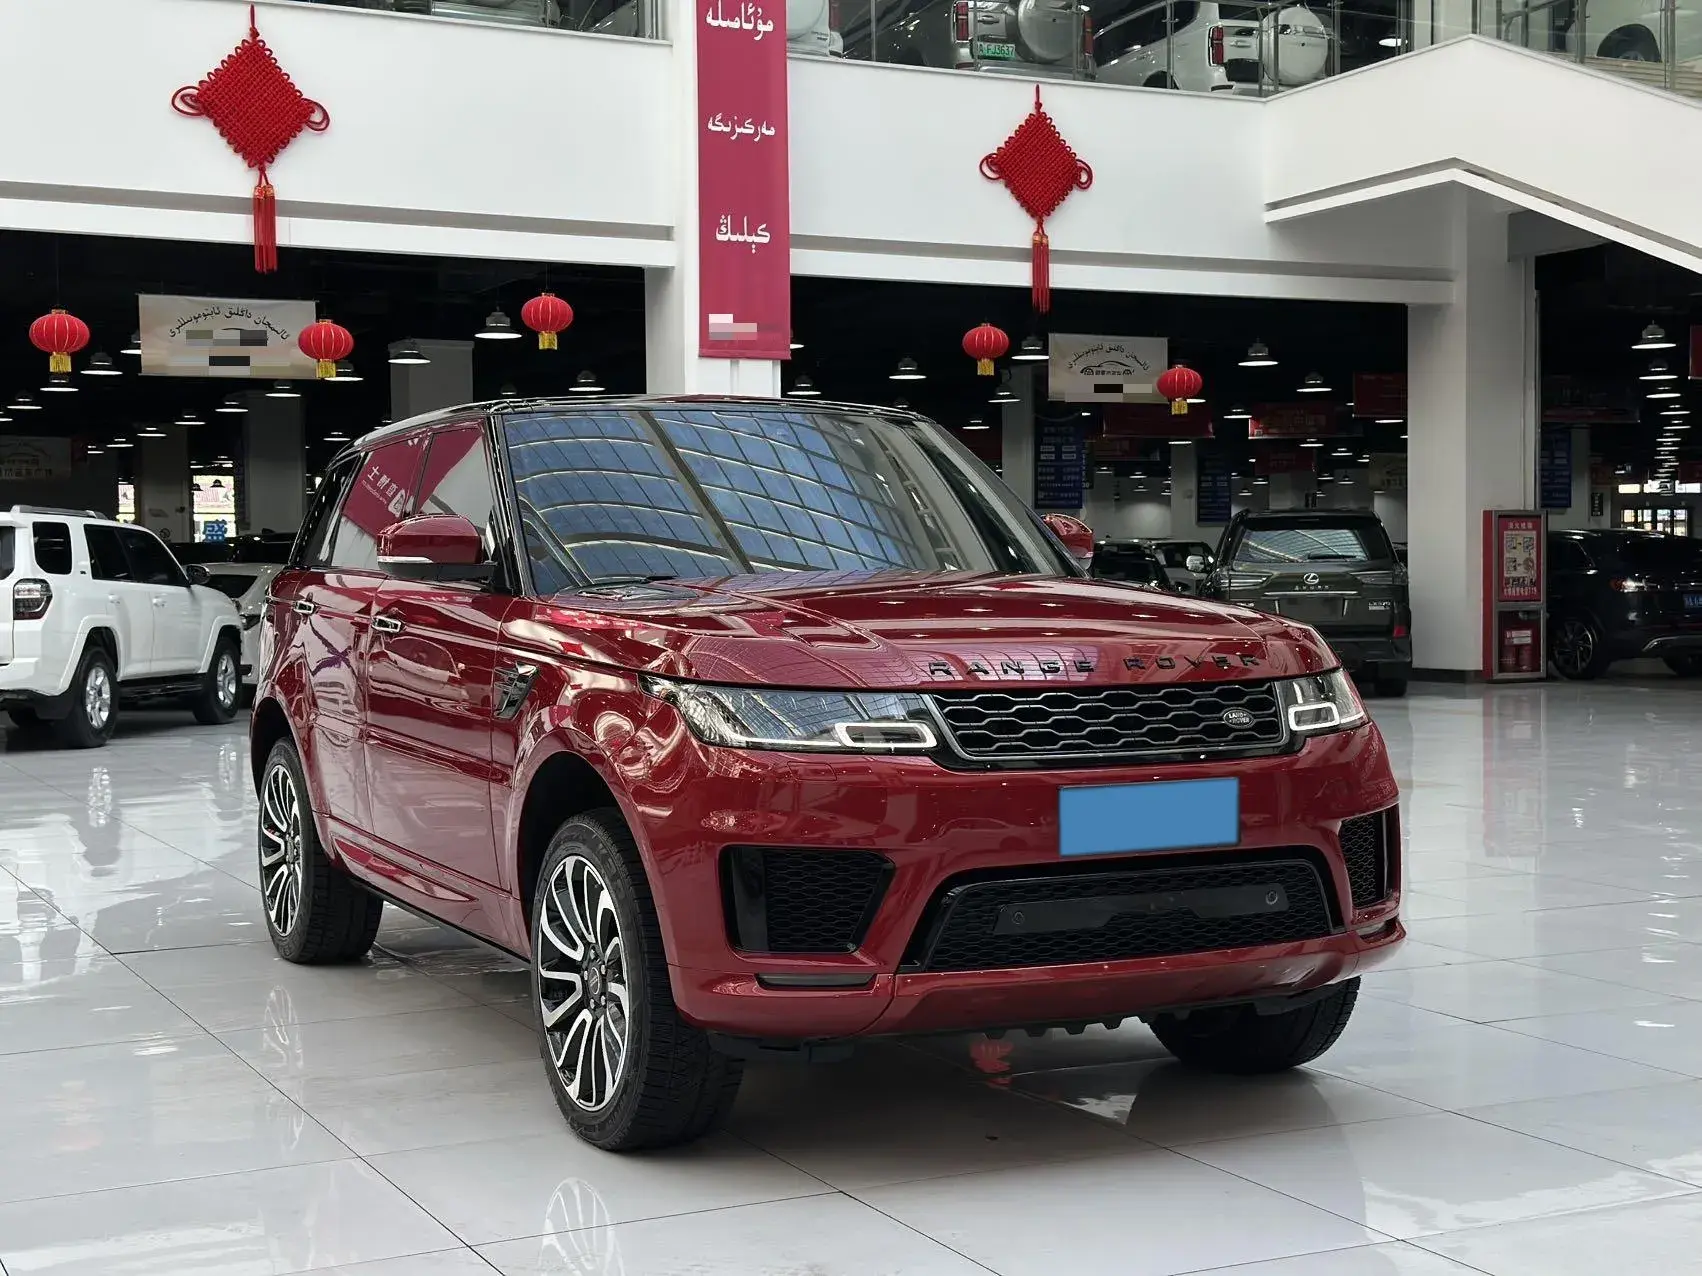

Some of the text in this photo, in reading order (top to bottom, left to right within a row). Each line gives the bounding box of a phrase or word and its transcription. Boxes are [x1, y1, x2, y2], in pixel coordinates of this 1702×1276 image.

[715, 214, 771, 254] كېلىڭ
[928, 654, 1261, 676] RANGE ROVER
